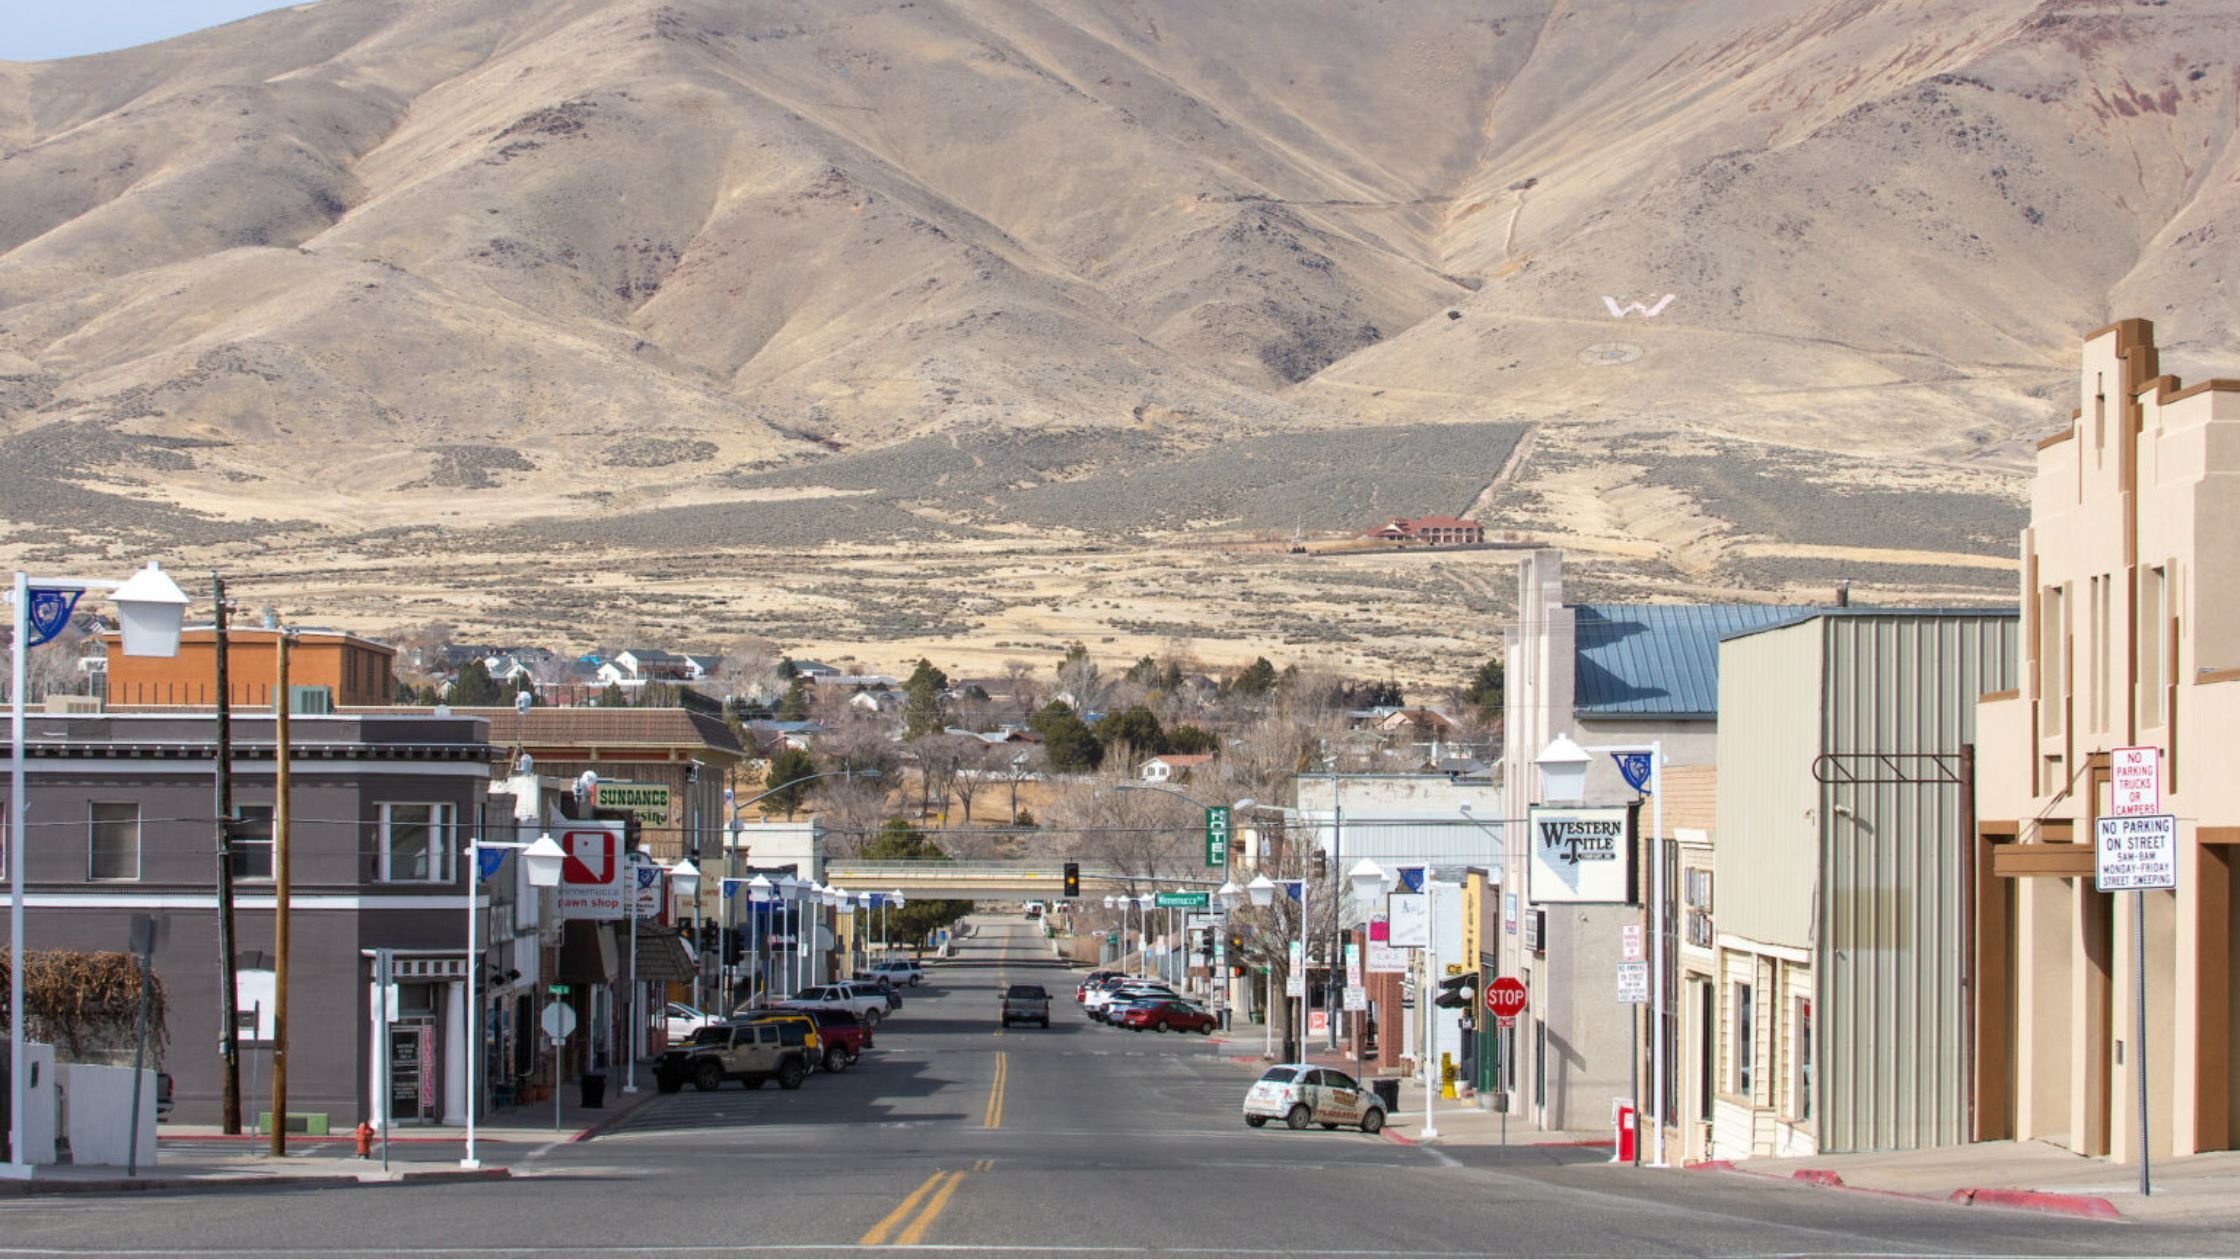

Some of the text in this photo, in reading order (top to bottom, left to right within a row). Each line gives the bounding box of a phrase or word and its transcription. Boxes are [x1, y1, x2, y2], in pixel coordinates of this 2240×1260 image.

[1601, 293, 1676, 318] W
[2127, 752, 2142, 763] NO
[2116, 765, 2154, 777] PARKING
[2119, 778, 2151, 789] TRUCKS
[600, 789, 668, 806] SUNDANCE
[2129, 791, 2141, 802] OR
[2116, 804, 2155, 816] CAMPERS
[2102, 819, 2170, 835] NO PARKING
[1540, 822, 1621, 848] WESTERN
[2106, 836, 2166, 851] ON STREET
[1565, 838, 1615, 865] TITLE
[2103, 862, 2169, 875] MONDAY-FRIDAY
[2103, 874, 2171, 887] STREET SWEEPING
[558, 898, 619, 908] pawn shop
[1488, 989, 1525, 1006] STOP
